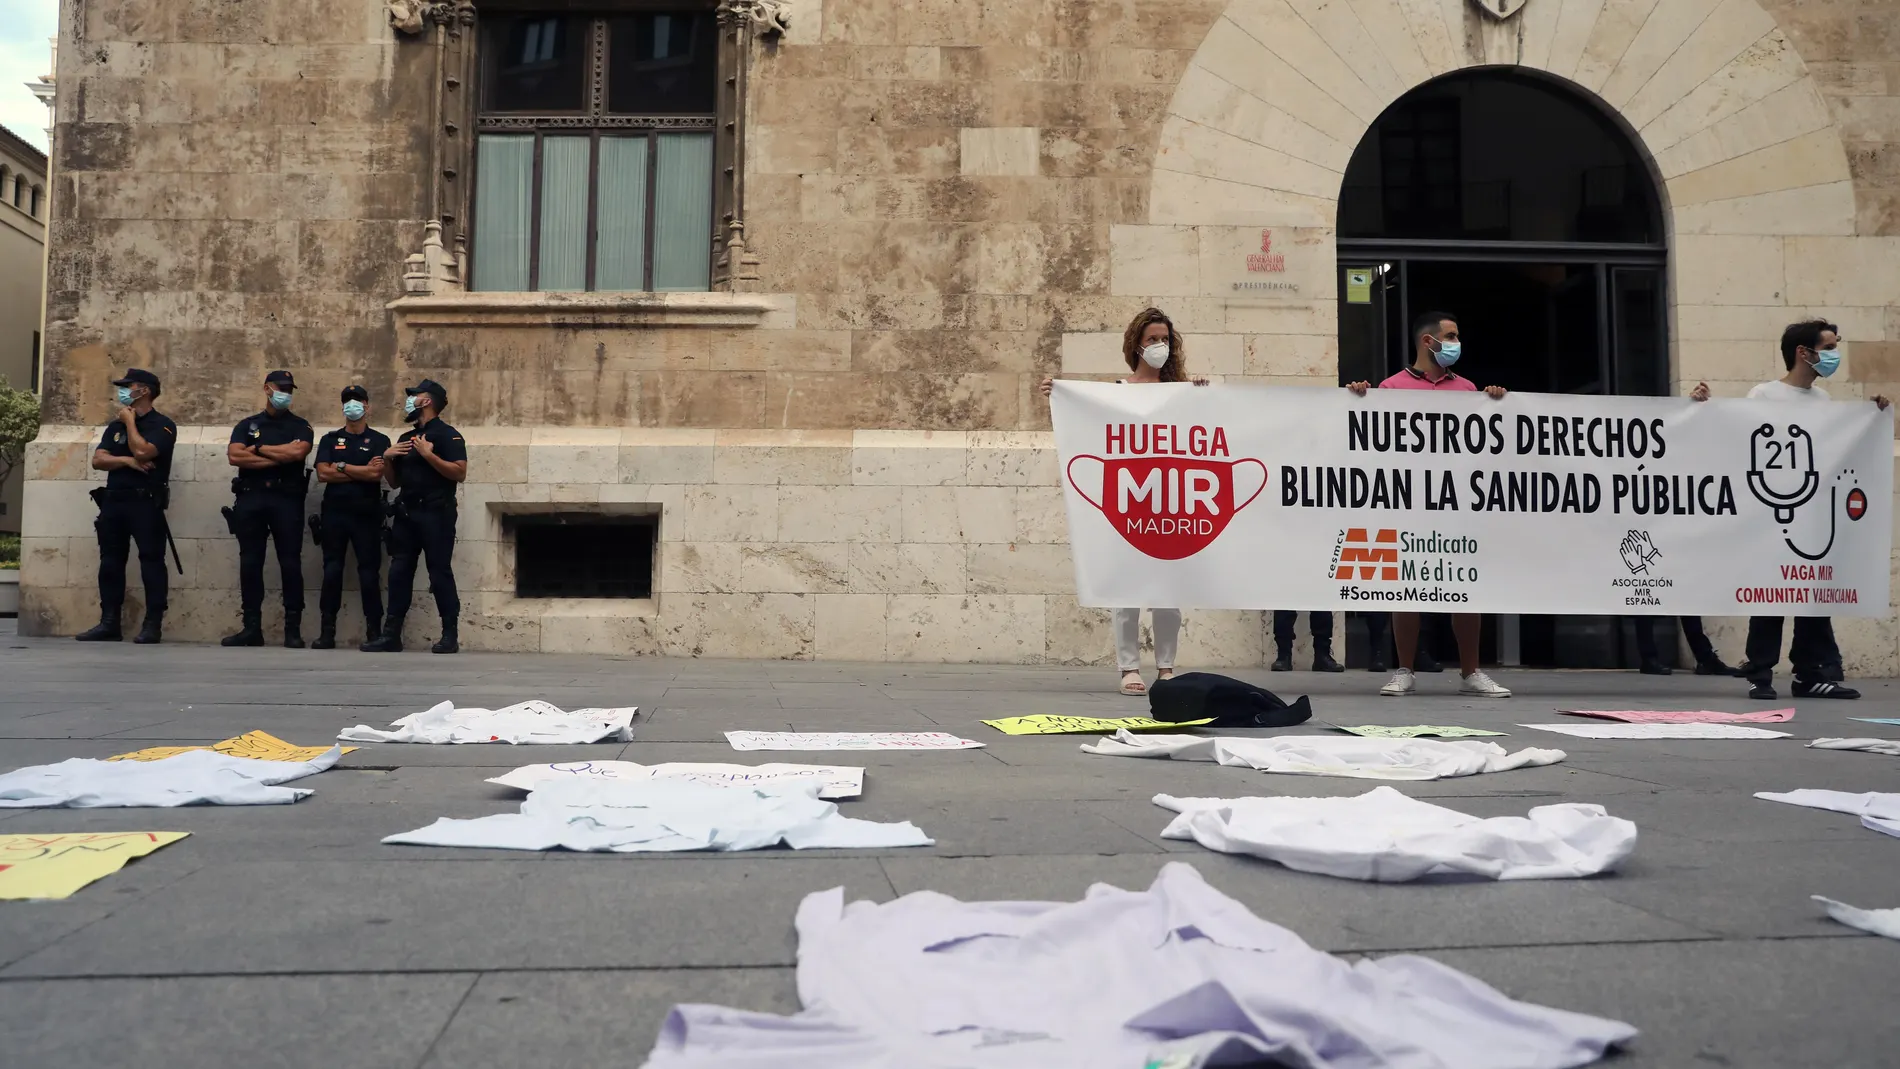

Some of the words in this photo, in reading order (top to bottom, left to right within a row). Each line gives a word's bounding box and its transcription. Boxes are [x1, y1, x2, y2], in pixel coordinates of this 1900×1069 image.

[1246, 263, 1286, 272] VALENCIANA
[1105, 423, 1230, 457] HUELGA
[1348, 410, 1505, 454] NUESTROS
[1516, 414, 1666, 459] DERECHOS
[1764, 440, 1798, 470] 21
[1117, 467, 1220, 517] MIR
[1281, 465, 1412, 510] BLINDAN
[1424, 469, 1460, 511] LA
[1469, 469, 1602, 514] SANIDAD
[1612, 464, 1738, 516] PÚBLICA
[1126, 517, 1213, 535] MADRID
[1400, 529, 1478, 554] Sindicato
[1401, 558, 1478, 583] Médico
[1780, 564, 1816, 581] VAGA
[1817, 565, 1834, 581] MIR
[1611, 577, 1674, 588] ASOCIACIÓN
[1339, 585, 1469, 603] #SomosMédicos
[1625, 595, 1662, 606] ESPAÑA
[1634, 588, 1652, 598] MIR
[1735, 587, 1810, 604] COMUNITAT
[1812, 588, 1858, 604] VALENCIANA
